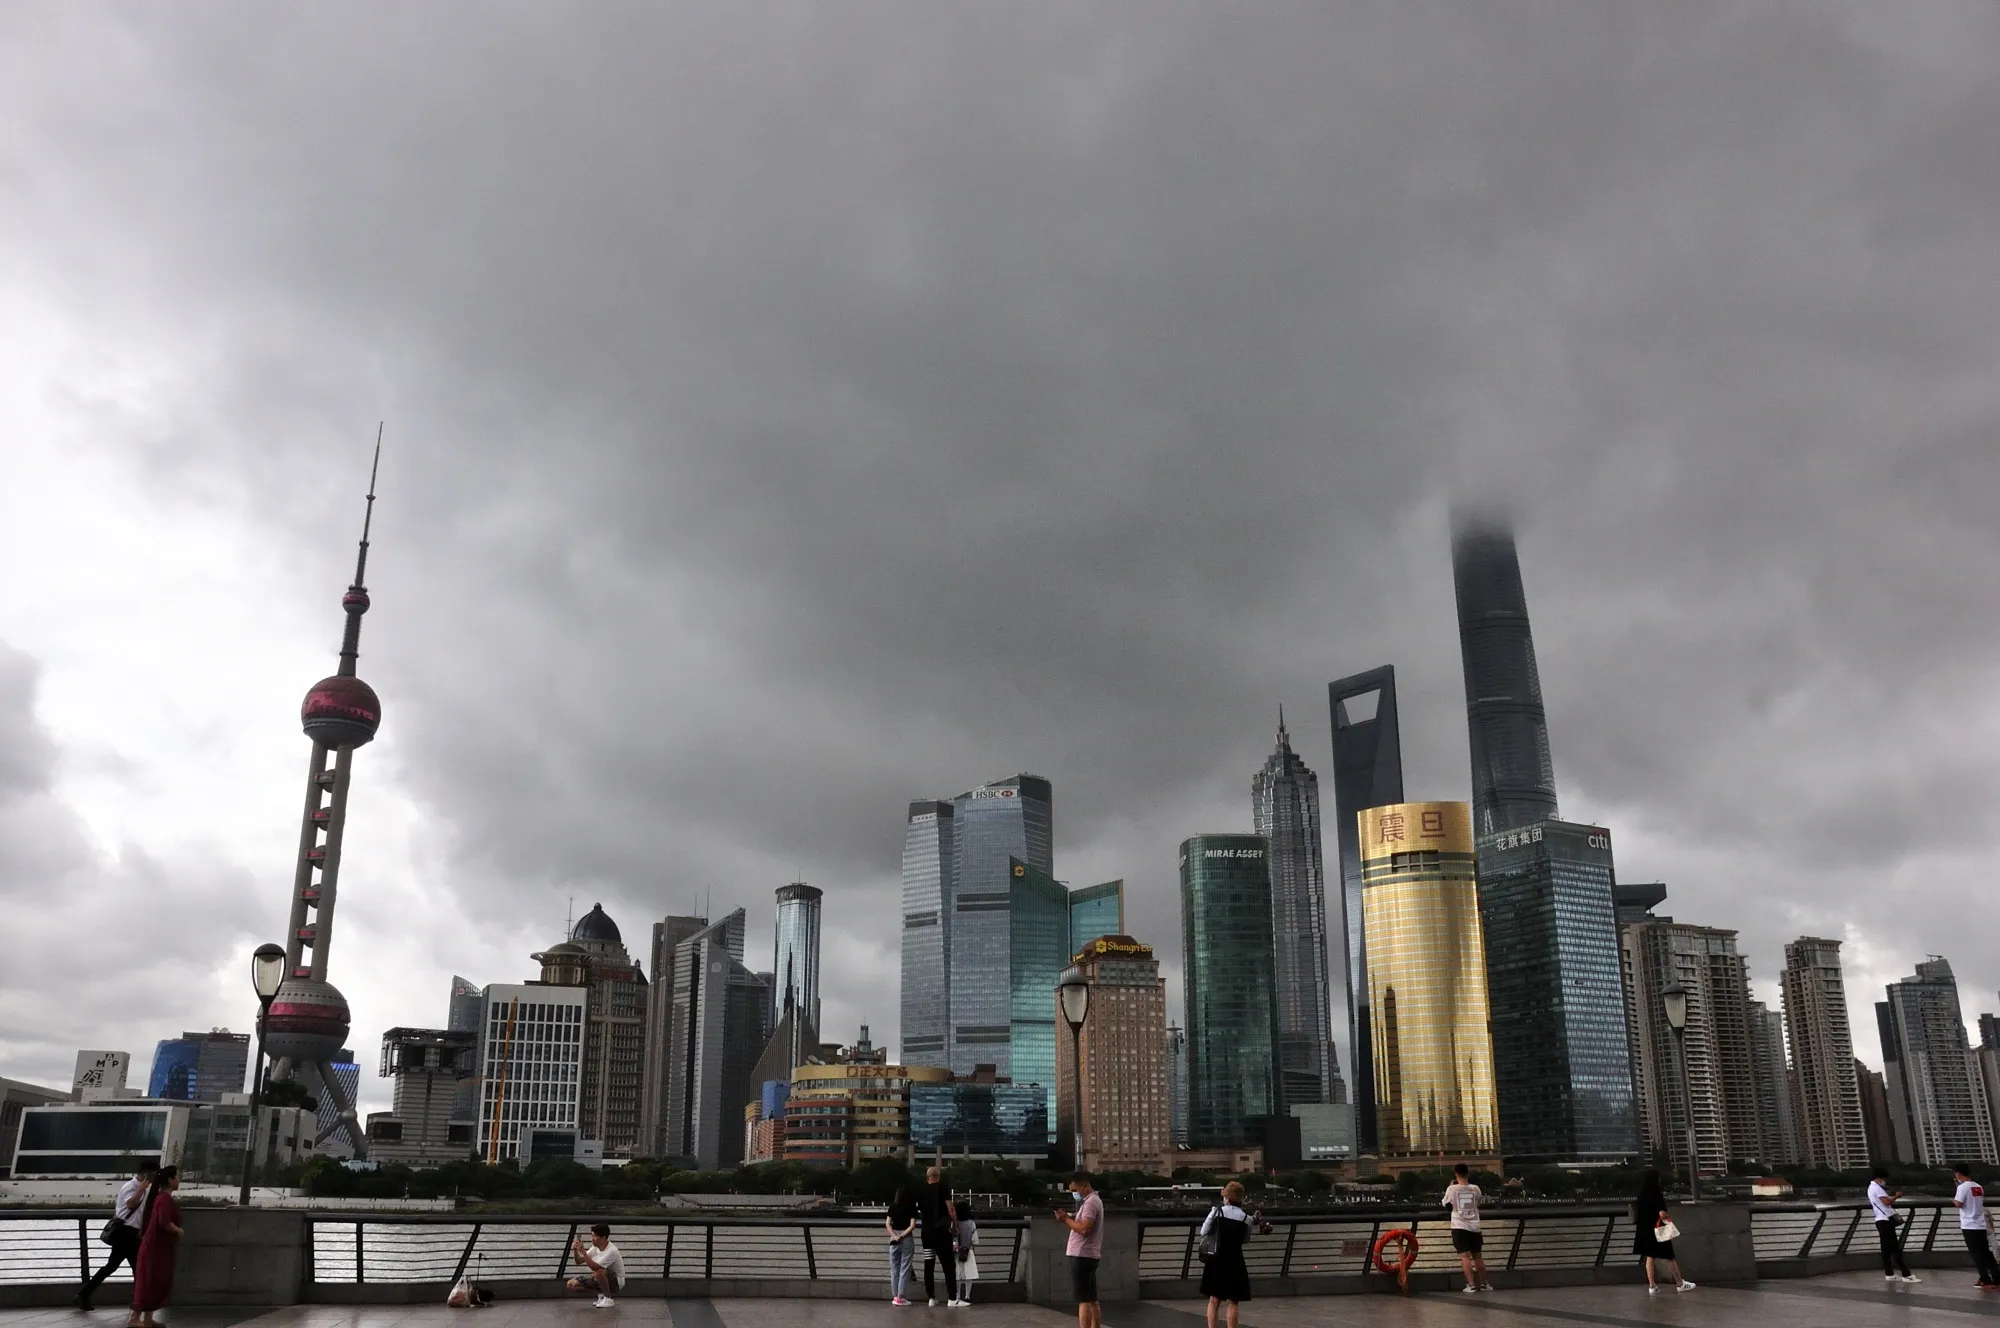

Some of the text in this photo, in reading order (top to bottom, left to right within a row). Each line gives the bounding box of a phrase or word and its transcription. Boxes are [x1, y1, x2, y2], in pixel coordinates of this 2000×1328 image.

[1380, 811, 1446, 844] 震旦
[1496, 827, 1543, 852] 花旗集团
[1588, 833, 1608, 849] citi
[1205, 849, 1264, 858] MIRAE ASSET
[860, 1066, 908, 1078] 正大广场
